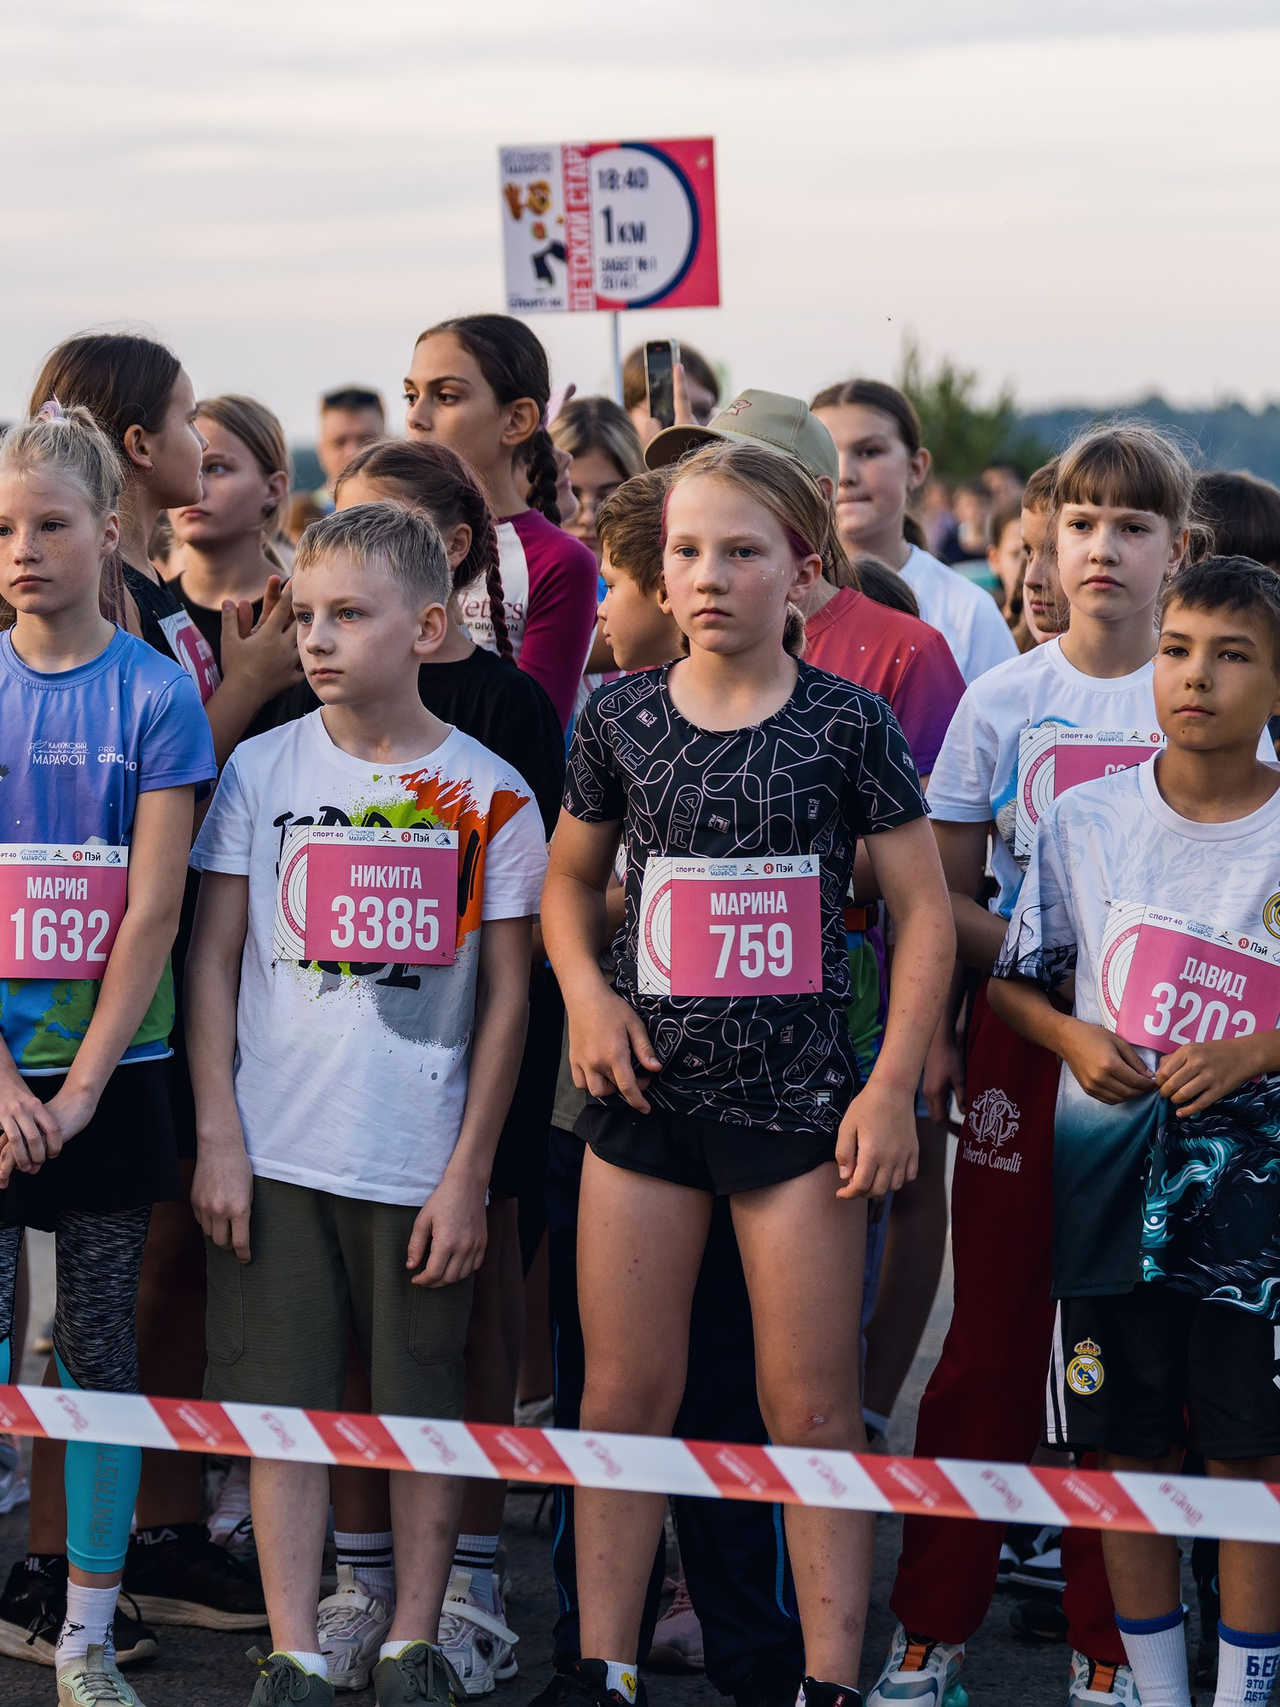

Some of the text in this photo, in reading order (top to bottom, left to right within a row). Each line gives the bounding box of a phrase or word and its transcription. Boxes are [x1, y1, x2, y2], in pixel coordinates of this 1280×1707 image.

[598, 167, 649, 190] 18:40
[601, 205, 613, 244] 1
[600, 677, 654, 715] FILA
[607, 722, 646, 770] FILA
[32, 754, 86, 765] МАРАФОН
[670, 792, 700, 848] FILA
[413, 833, 430, 843] Пэй
[85, 851, 101, 861] Пэй
[776, 863, 793, 873] Пэй
[26, 876, 88, 900] МАРИЯ
[350, 864, 422, 889] НИКИТА
[710, 891, 788, 916] МАРИНА
[330, 895, 439, 951] 3385
[1149, 913, 1173, 923] СПОРТ
[10, 907, 110, 962] 1632
[709, 922, 793, 979] 759
[1250, 942, 1268, 955] Пэй
[1179, 956, 1247, 1001] ДАВИД
[989, 1148, 1022, 1173] Cavalli
[1246, 1679, 1264, 1689] ЭТО
